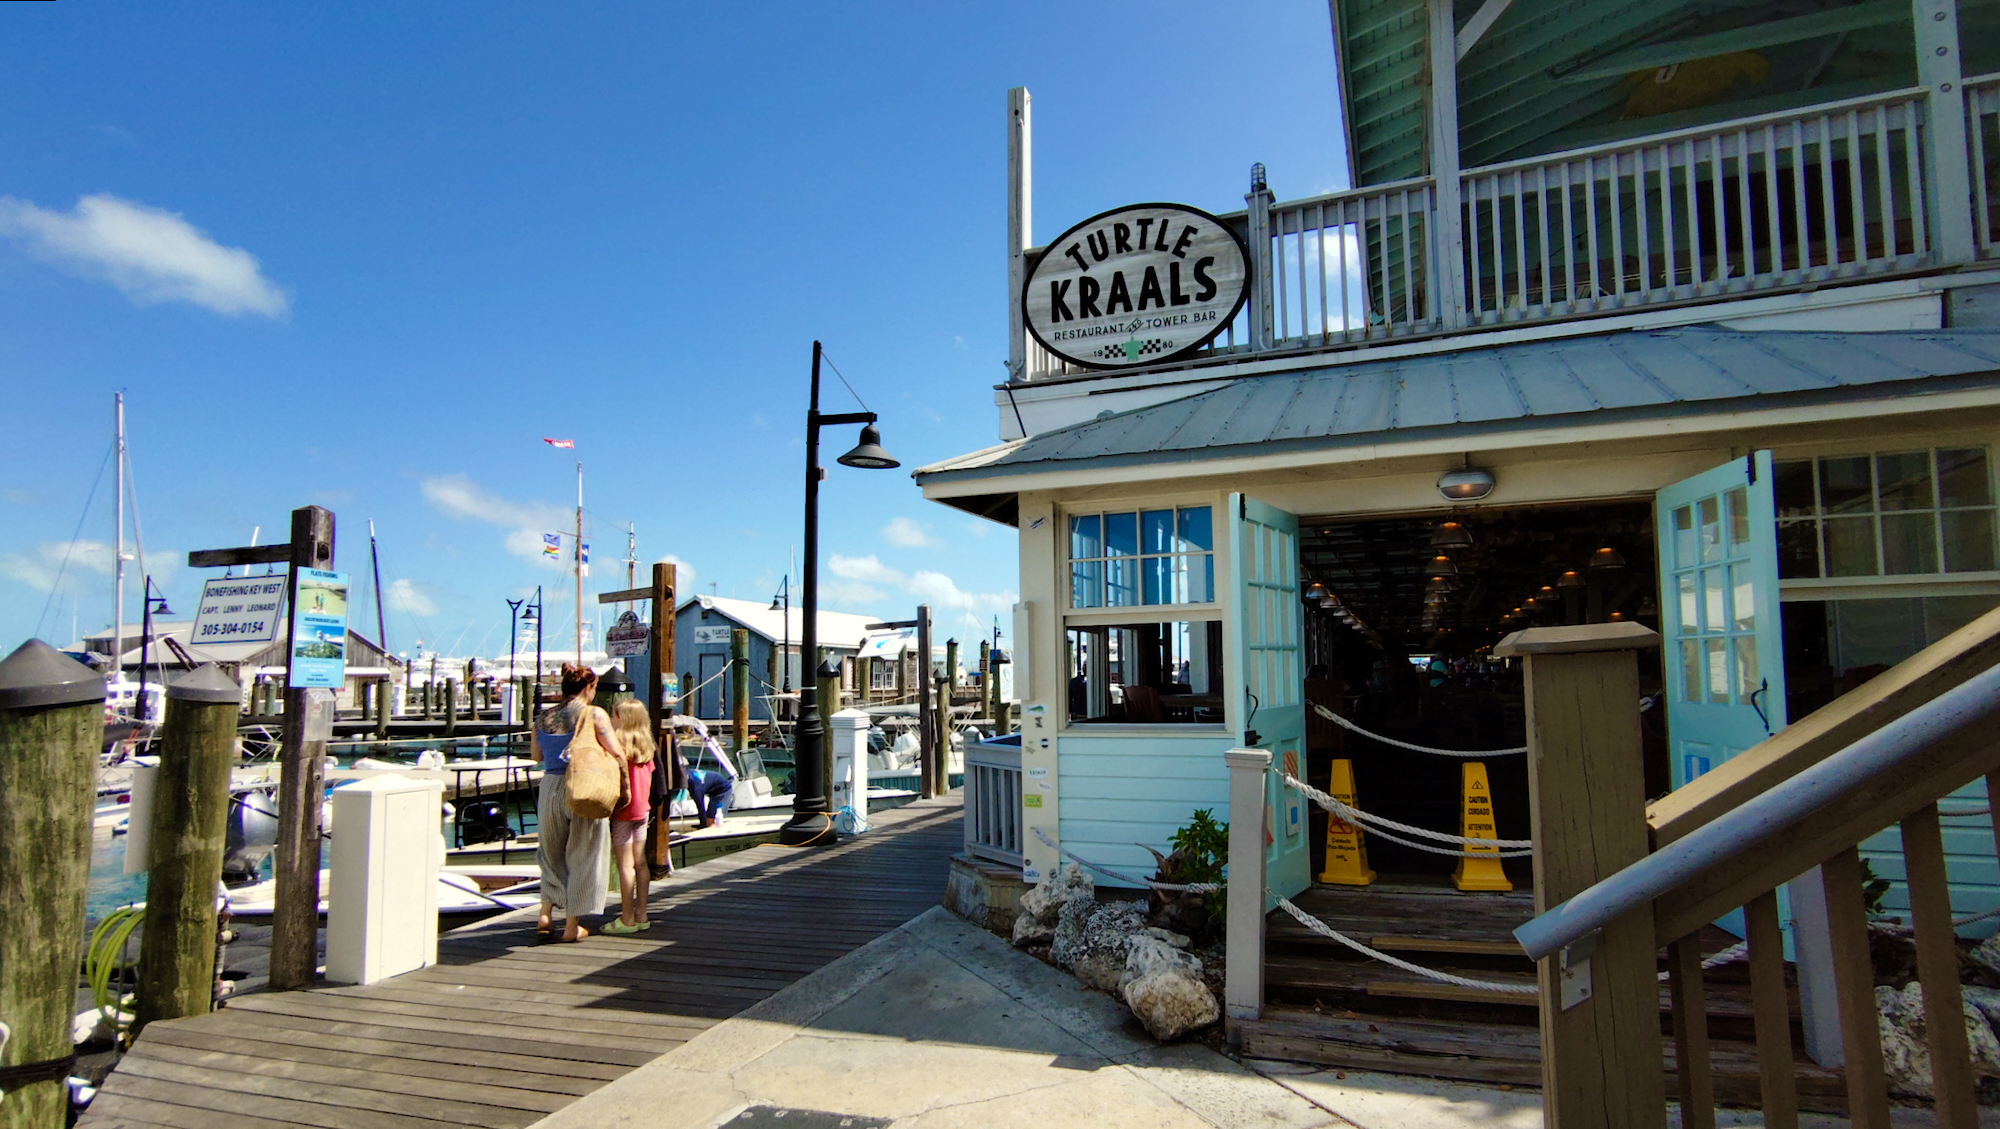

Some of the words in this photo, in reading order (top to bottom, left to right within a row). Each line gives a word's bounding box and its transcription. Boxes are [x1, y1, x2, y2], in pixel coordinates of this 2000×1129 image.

[1065, 218, 1198, 272] TURTLE
[1051, 256, 1217, 324] KRAALS
[1054, 322, 1125, 341] RESTAURANT
[1146, 314, 1188, 330] TOWER
[1194, 310, 1216, 323] BAR
[1093, 349, 1104, 359] 19
[1162, 340, 1174, 349] 80
[205, 585, 249, 598] BONEFISHING
[249, 584, 263, 595] KEY
[263, 583, 281, 594] WEST
[202, 606, 219, 615] CAPT.
[223, 605, 243, 614] LENNY
[247, 603, 276, 612] LEONARD
[201, 621, 264, 636] 305-304-0154
[1468, 823, 1492, 831] ATTENTION
